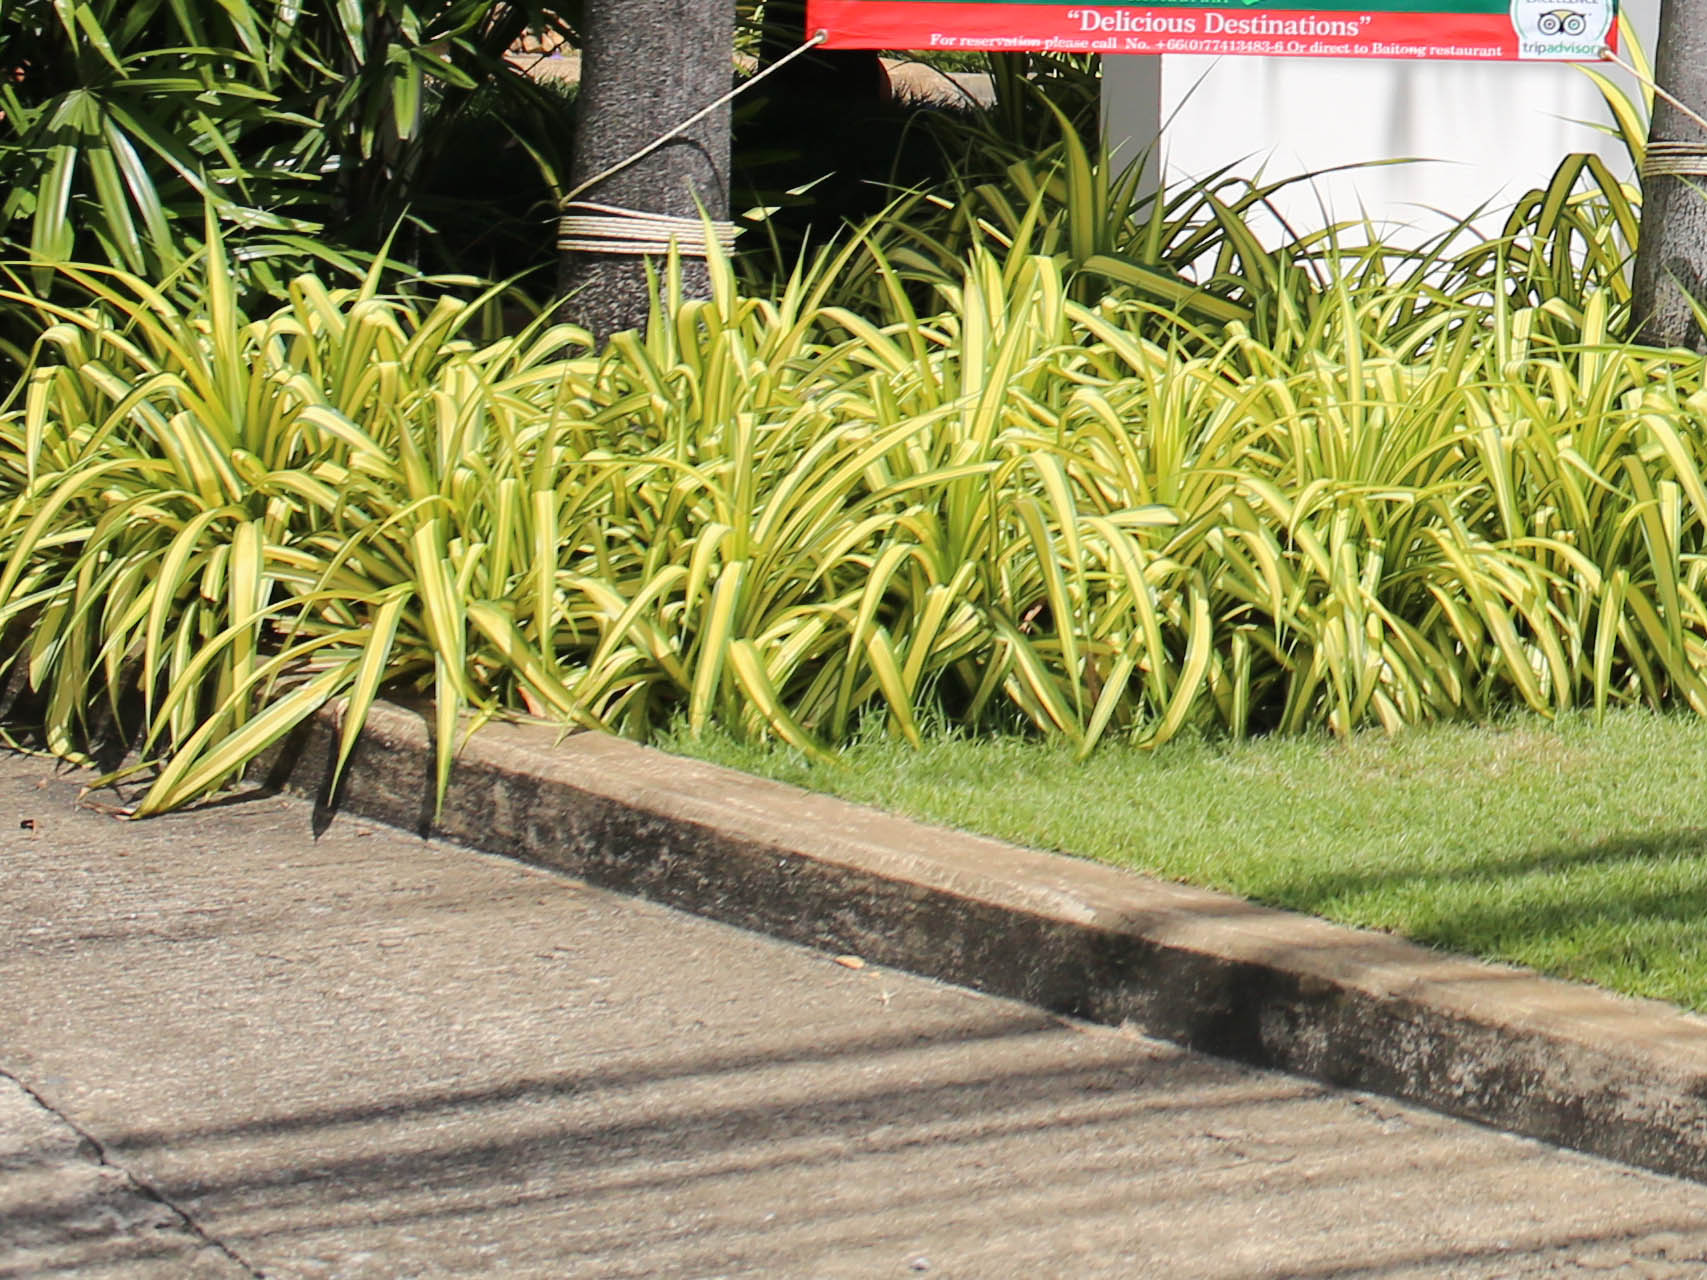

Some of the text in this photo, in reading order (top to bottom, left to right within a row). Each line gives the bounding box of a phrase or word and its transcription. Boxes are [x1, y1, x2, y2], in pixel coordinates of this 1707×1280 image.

[1067, 10, 1371, 37] “Delicious Destinations”
[930, 33, 957, 46] For
[960, 36, 1040, 47] reservation
[1044, 36, 1090, 51] please
[1091, 37, 1117, 50] call
[1125, 38, 1150, 50] No.
[1287, 41, 1307, 53] Or
[1309, 41, 1350, 54] direct
[1354, 43, 1368, 54] to
[1372, 42, 1426, 57] Baitong
[1429, 45, 1502, 57] restaurant
[1523, 41, 1596, 55] tripadvisor
